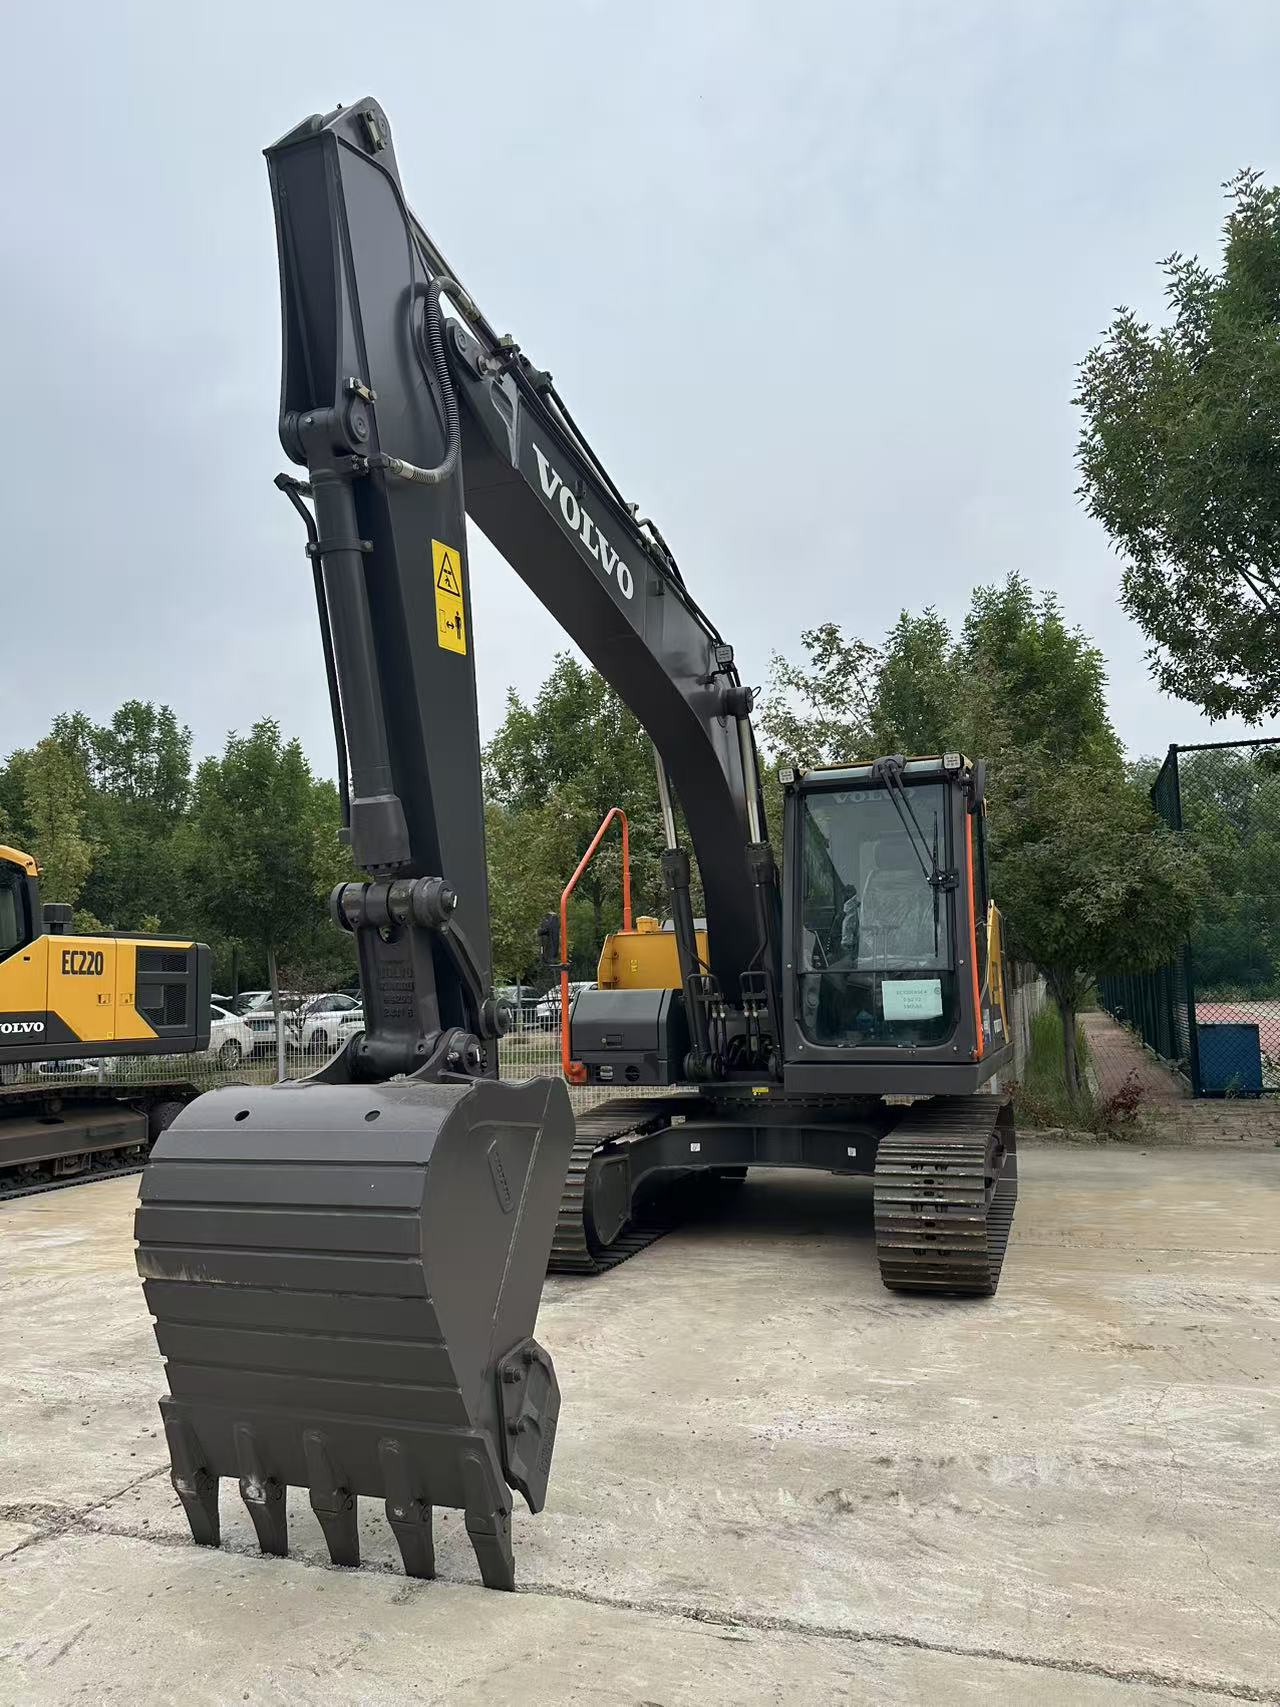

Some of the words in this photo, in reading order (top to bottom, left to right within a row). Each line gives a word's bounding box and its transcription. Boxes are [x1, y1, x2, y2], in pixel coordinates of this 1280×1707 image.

[532, 442, 634, 600] VOLVO
[62, 950, 104, 975] EC220
[0, 1021, 45, 1034] OLVO
